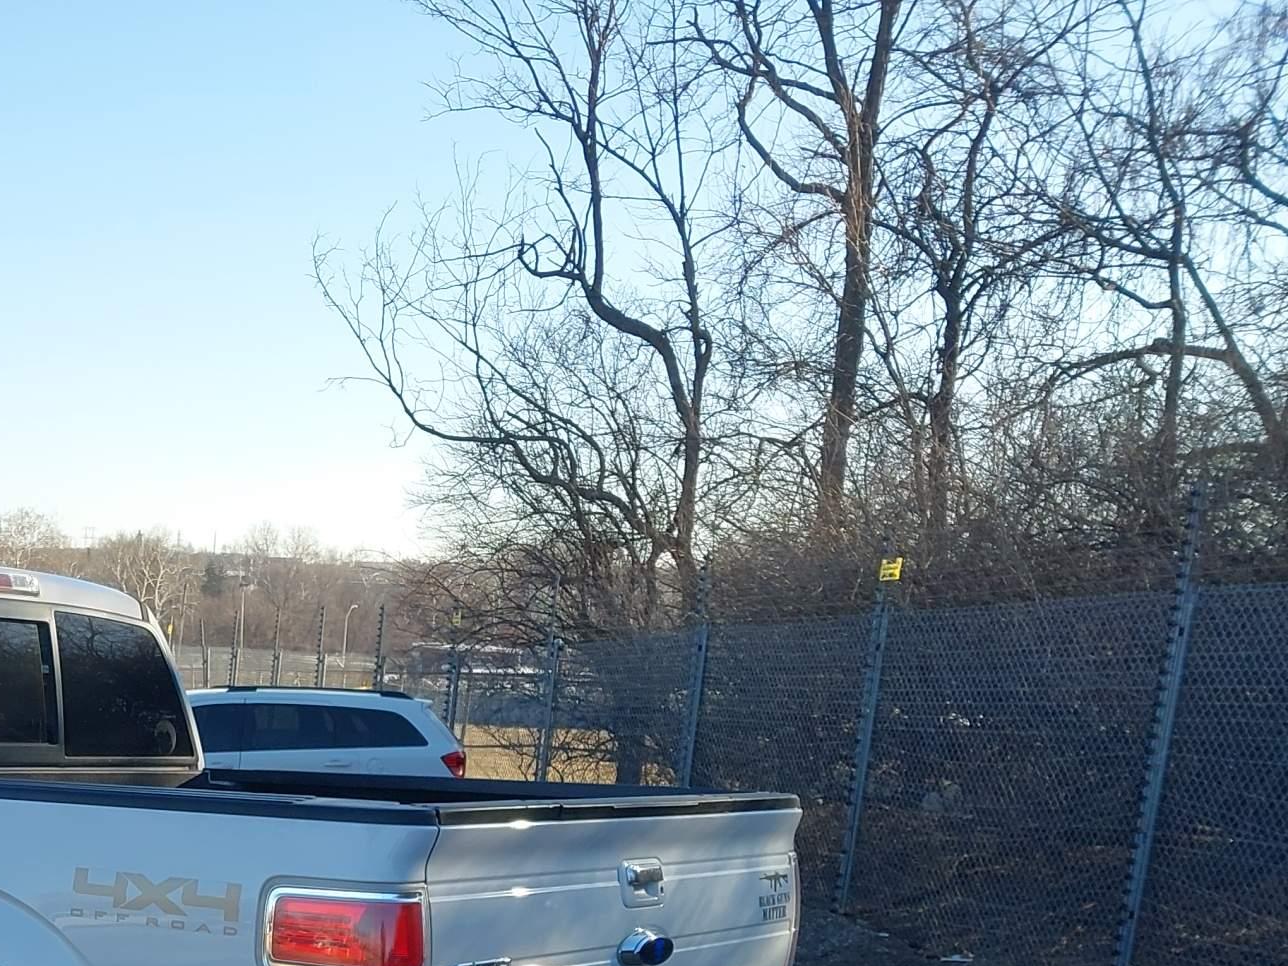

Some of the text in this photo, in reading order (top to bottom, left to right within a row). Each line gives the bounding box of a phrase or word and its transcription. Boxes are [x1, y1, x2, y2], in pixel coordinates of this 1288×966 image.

[70, 907, 239, 937] OFF ROAD
[762, 904, 787, 921] MATTER
